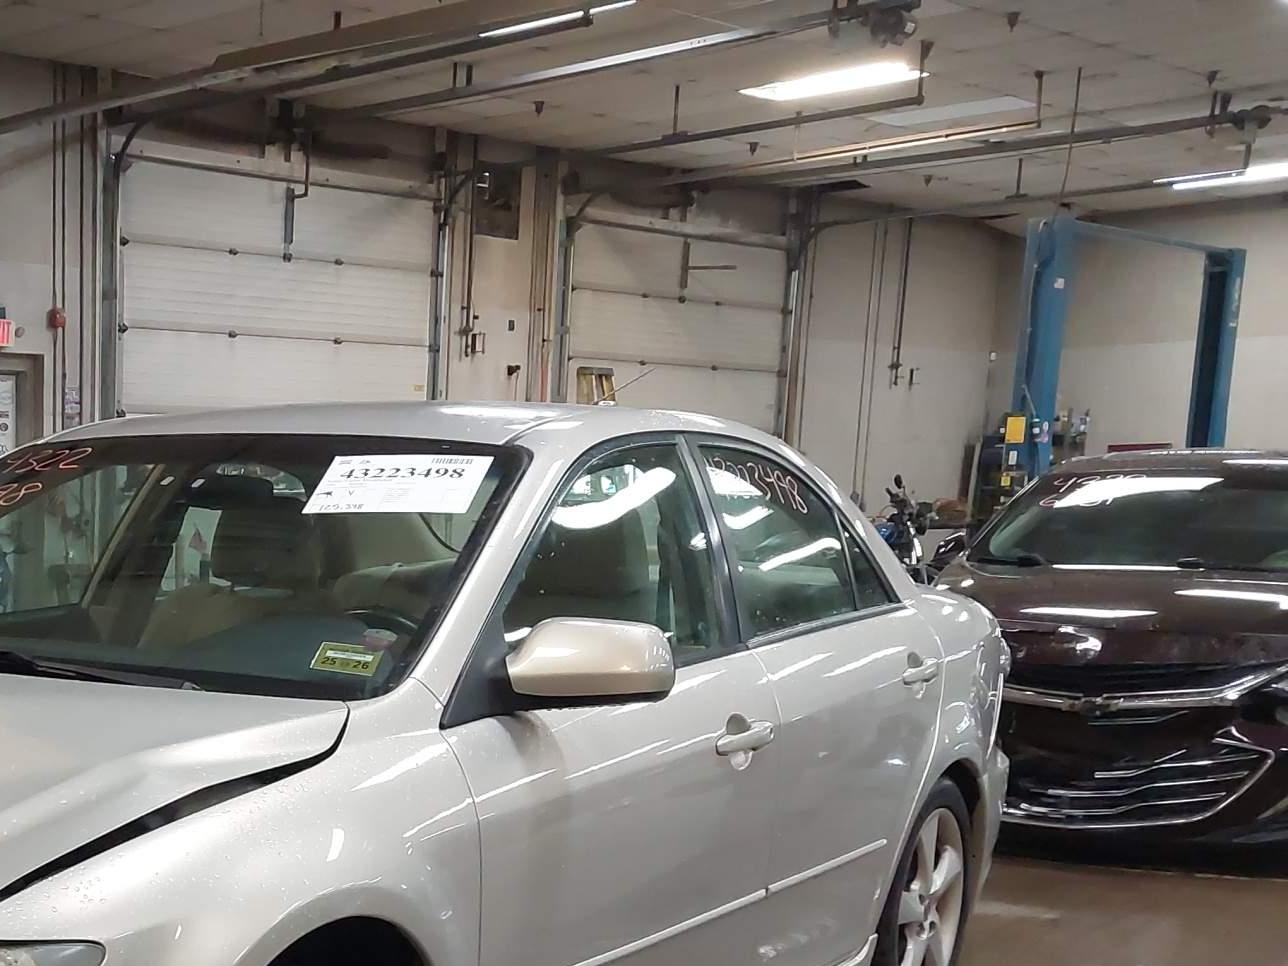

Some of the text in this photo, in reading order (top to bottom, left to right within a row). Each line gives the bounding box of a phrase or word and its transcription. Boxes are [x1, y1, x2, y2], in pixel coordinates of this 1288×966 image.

[340, 468, 465, 479] 43223498
[321, 657, 370, 669] 25 26
